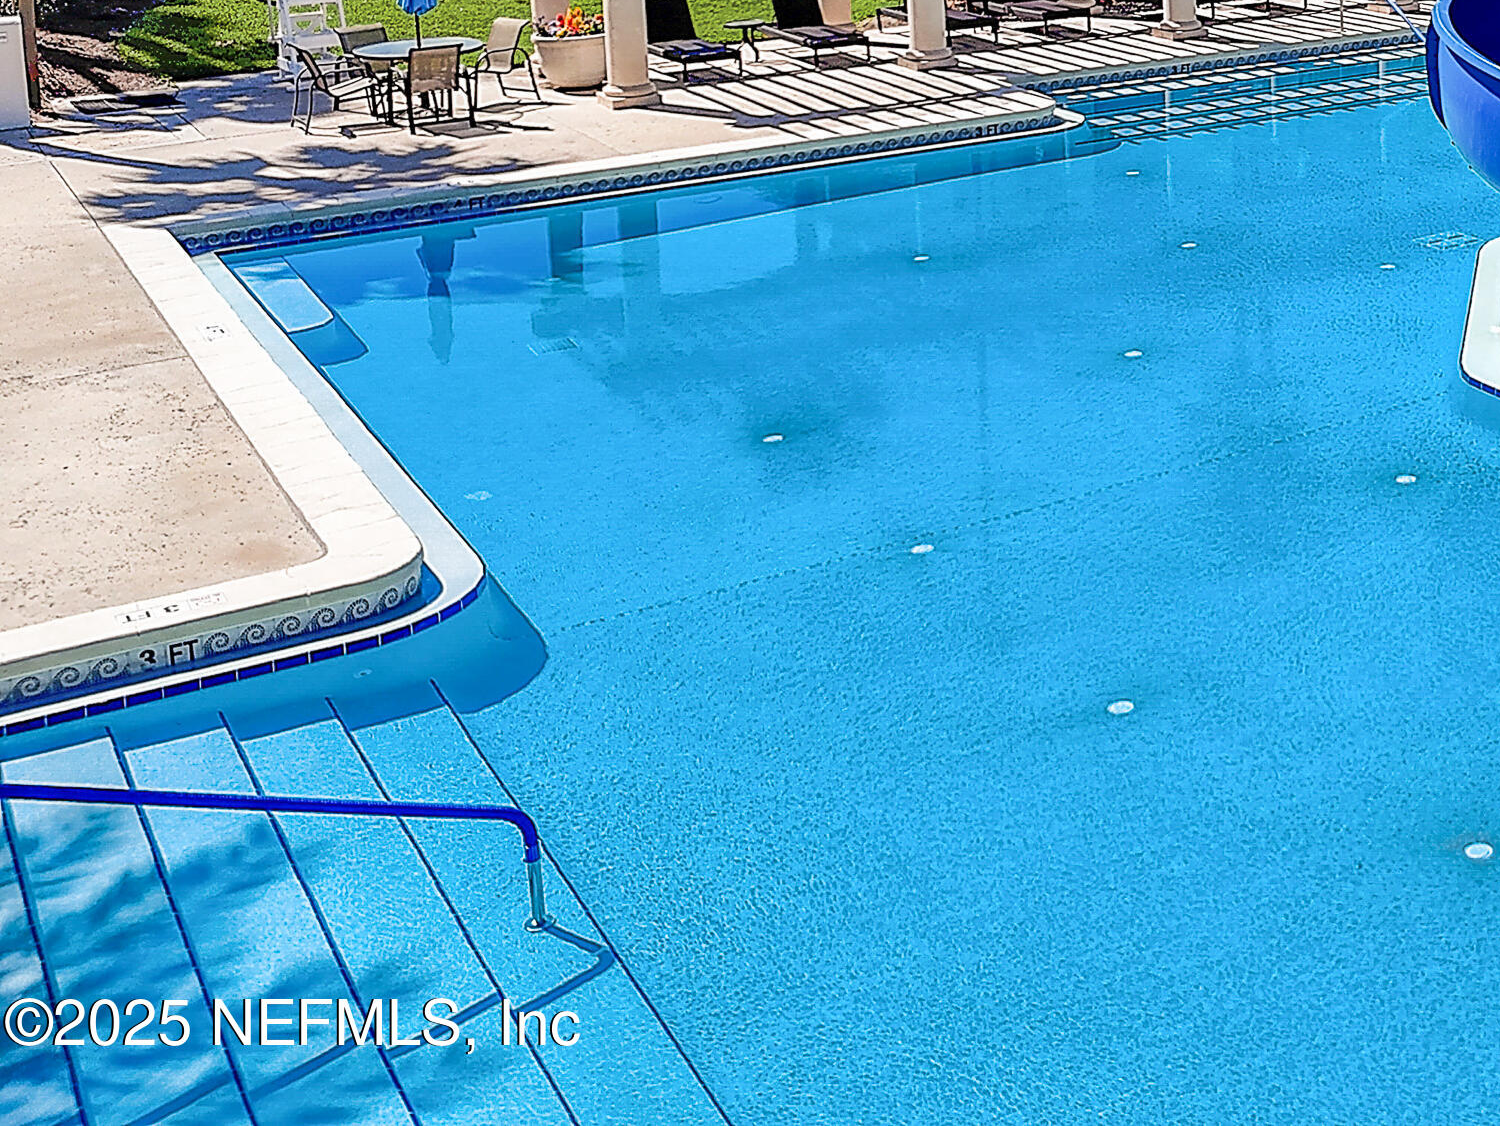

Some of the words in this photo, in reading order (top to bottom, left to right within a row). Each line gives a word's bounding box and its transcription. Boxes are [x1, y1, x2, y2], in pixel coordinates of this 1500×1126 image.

[1181, 63, 1191, 74] FT
[987, 123, 1000, 135] FT
[469, 196, 485, 210] FT
[138, 648, 157, 665] 3
[168, 638, 200, 667] FT
